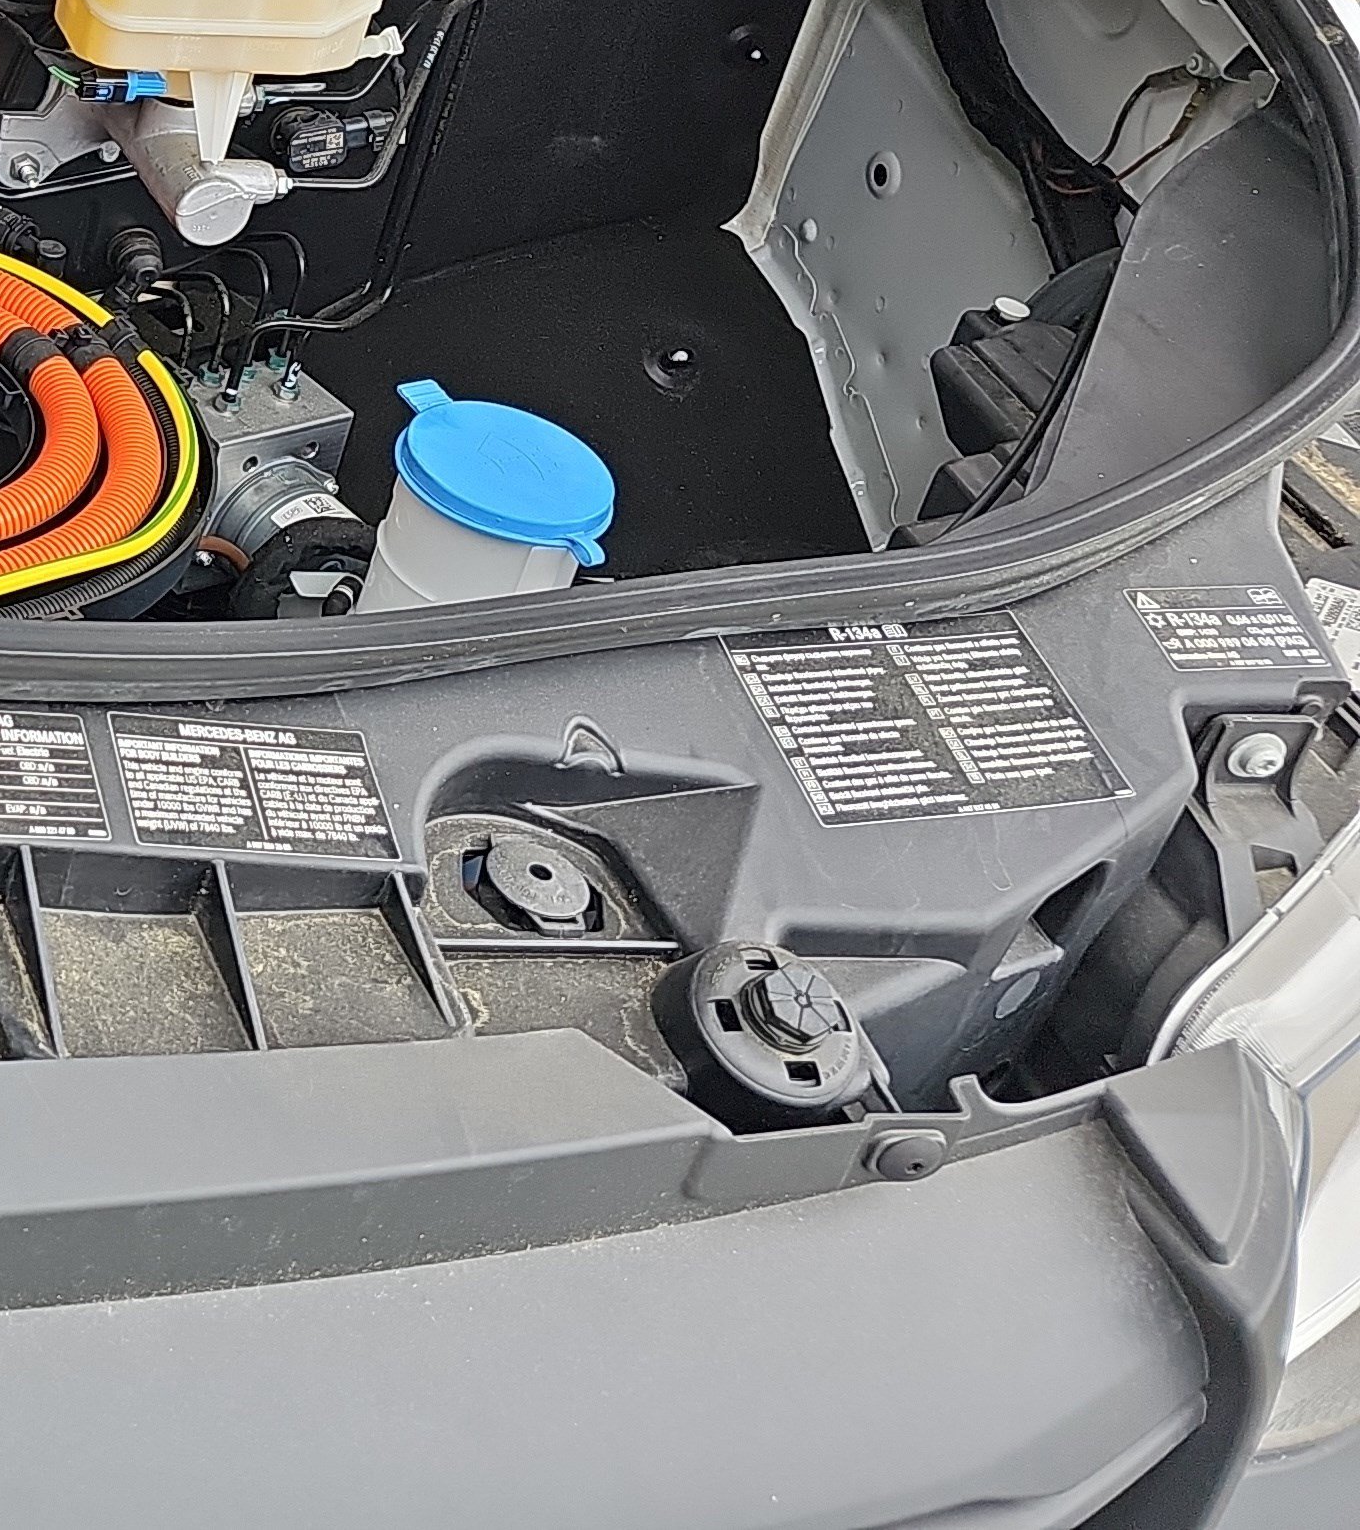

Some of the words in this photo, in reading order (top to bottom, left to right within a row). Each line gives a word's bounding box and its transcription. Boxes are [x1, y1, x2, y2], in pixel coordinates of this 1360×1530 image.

[1165, 612, 1222, 627] R-134a
[828, 626, 883, 642] R-134a
[1184, 639, 1196, 649] A
[1195, 638, 1218, 649] 000
[1218, 637, 1241, 648] 989
[0, 727, 85, 745] INFORMATION
[178, 722, 278, 743] MERCEDES-BENZ
[278, 731, 297, 746] AG
[16, 746, 50, 757] Electric
[118, 738, 163, 751] IMPORTANT
[163, 742, 220, 757] INFORMATION
[120, 748, 137, 758] FOR
[137, 750, 160, 760] BODY
[161, 751, 201, 764] BUILDERS
[250, 758, 275, 769] POUR
[123, 760, 140, 770] This
[140, 761, 167, 772] vehicle
[168, 764, 183, 774] and
[128, 780, 143, 789] and
[143, 781, 180, 792] Canadian
[180, 784, 223, 796] regulations
[185, 774, 198, 785] US
[217, 777, 240, 788] CARB
[260, 790, 282, 800] CARB
[328, 795, 358, 805] Canada
[350, 787, 368, 797] EPA
[156, 800, 181, 811] 10000
